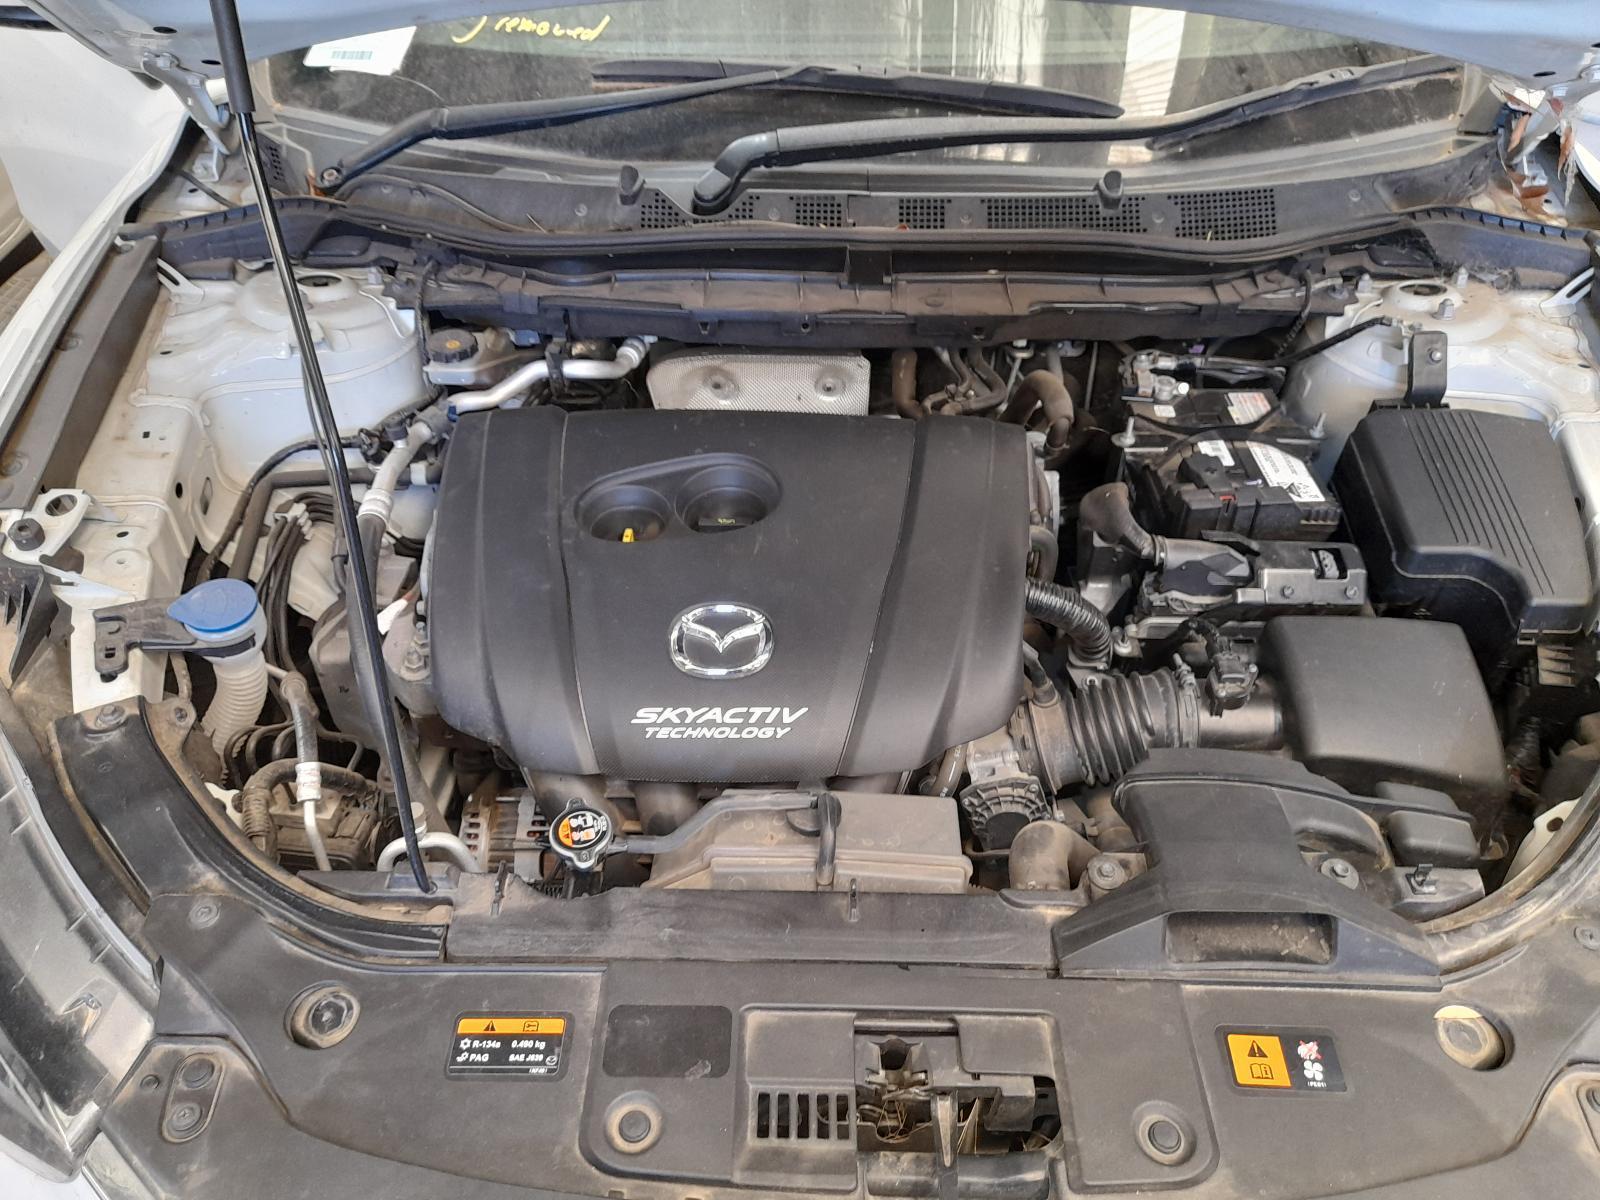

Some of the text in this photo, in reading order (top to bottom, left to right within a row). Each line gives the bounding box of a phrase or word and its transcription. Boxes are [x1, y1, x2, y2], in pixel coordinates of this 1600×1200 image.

[630, 707, 809, 724] SKYACTIV
[645, 727, 792, 739] TECHNOLOGY
[472, 1040, 501, 1049] R-134a
[535, 1040, 546, 1050] kg
[469, 1053, 489, 1062] PAG
